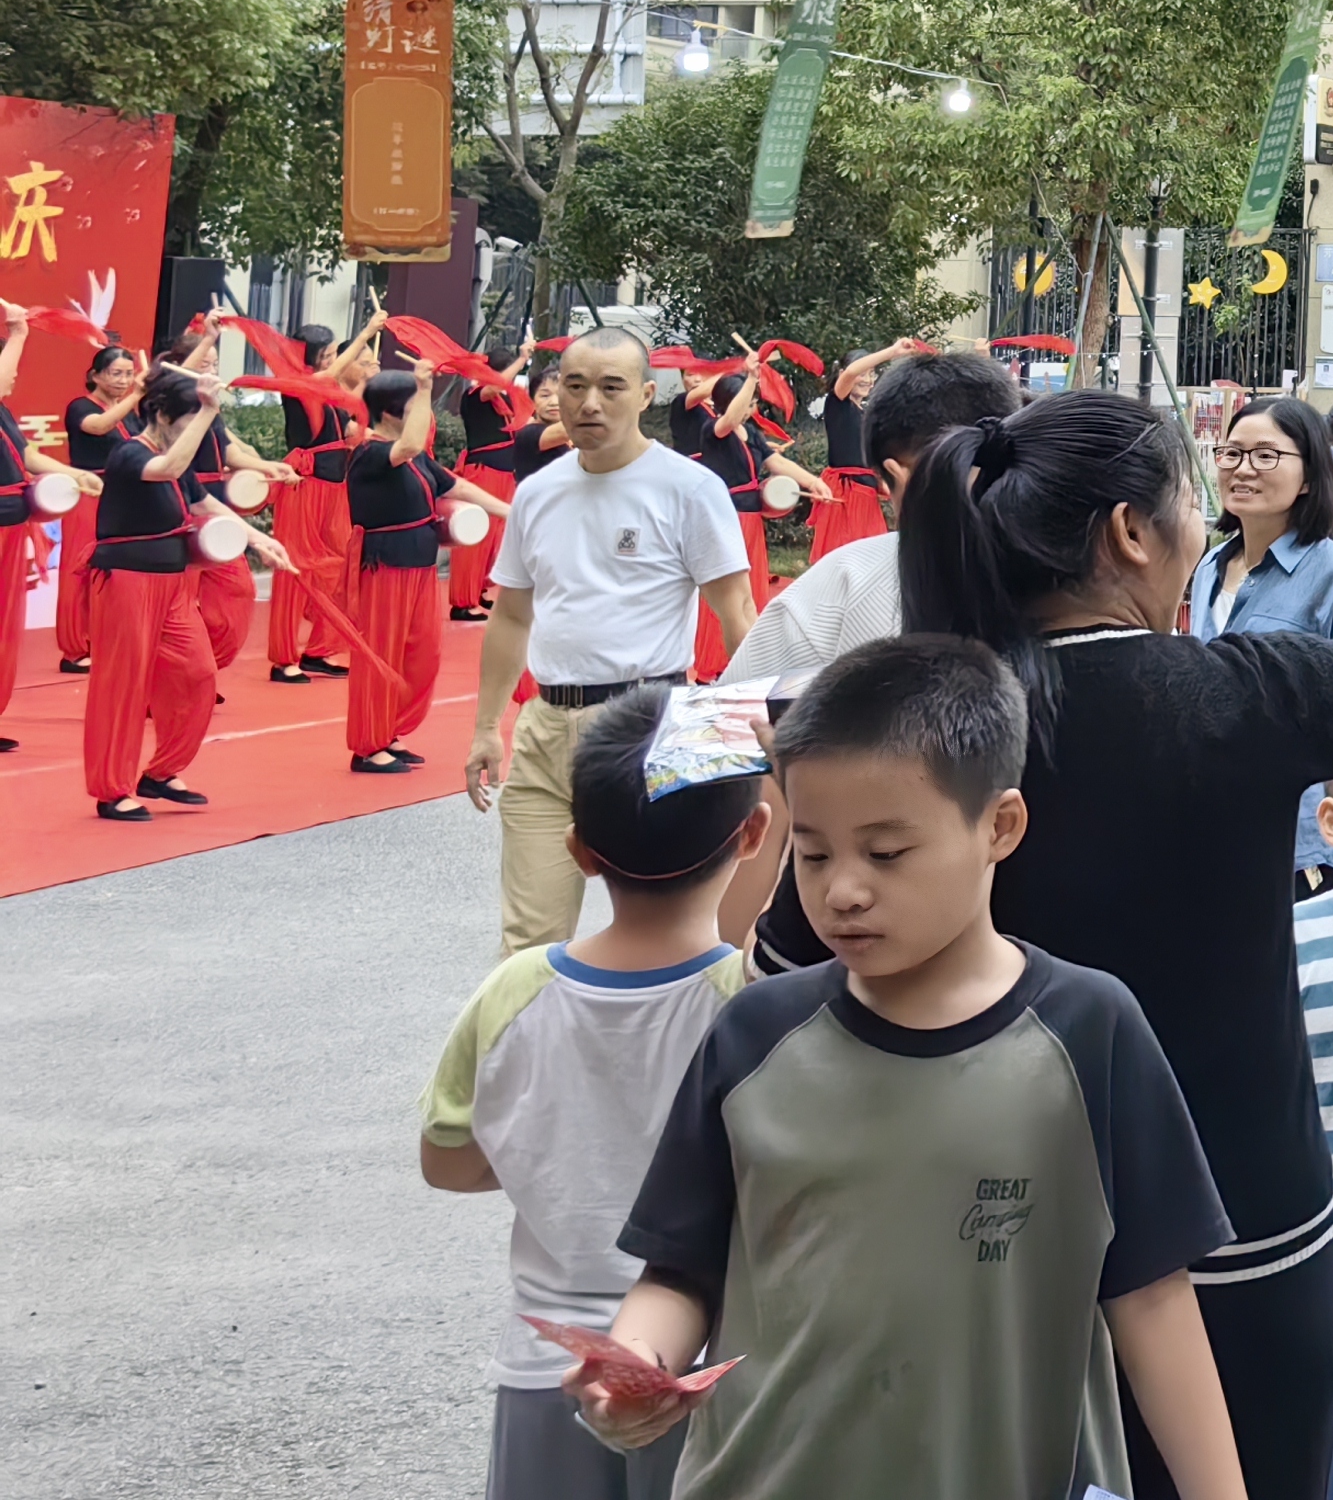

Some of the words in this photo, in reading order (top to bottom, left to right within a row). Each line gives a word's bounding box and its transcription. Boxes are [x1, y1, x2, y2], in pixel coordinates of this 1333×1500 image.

[0, 160, 65, 262] 庆
[976, 1178, 1033, 1201] GREAT
[977, 1238, 1012, 1262] DAY
